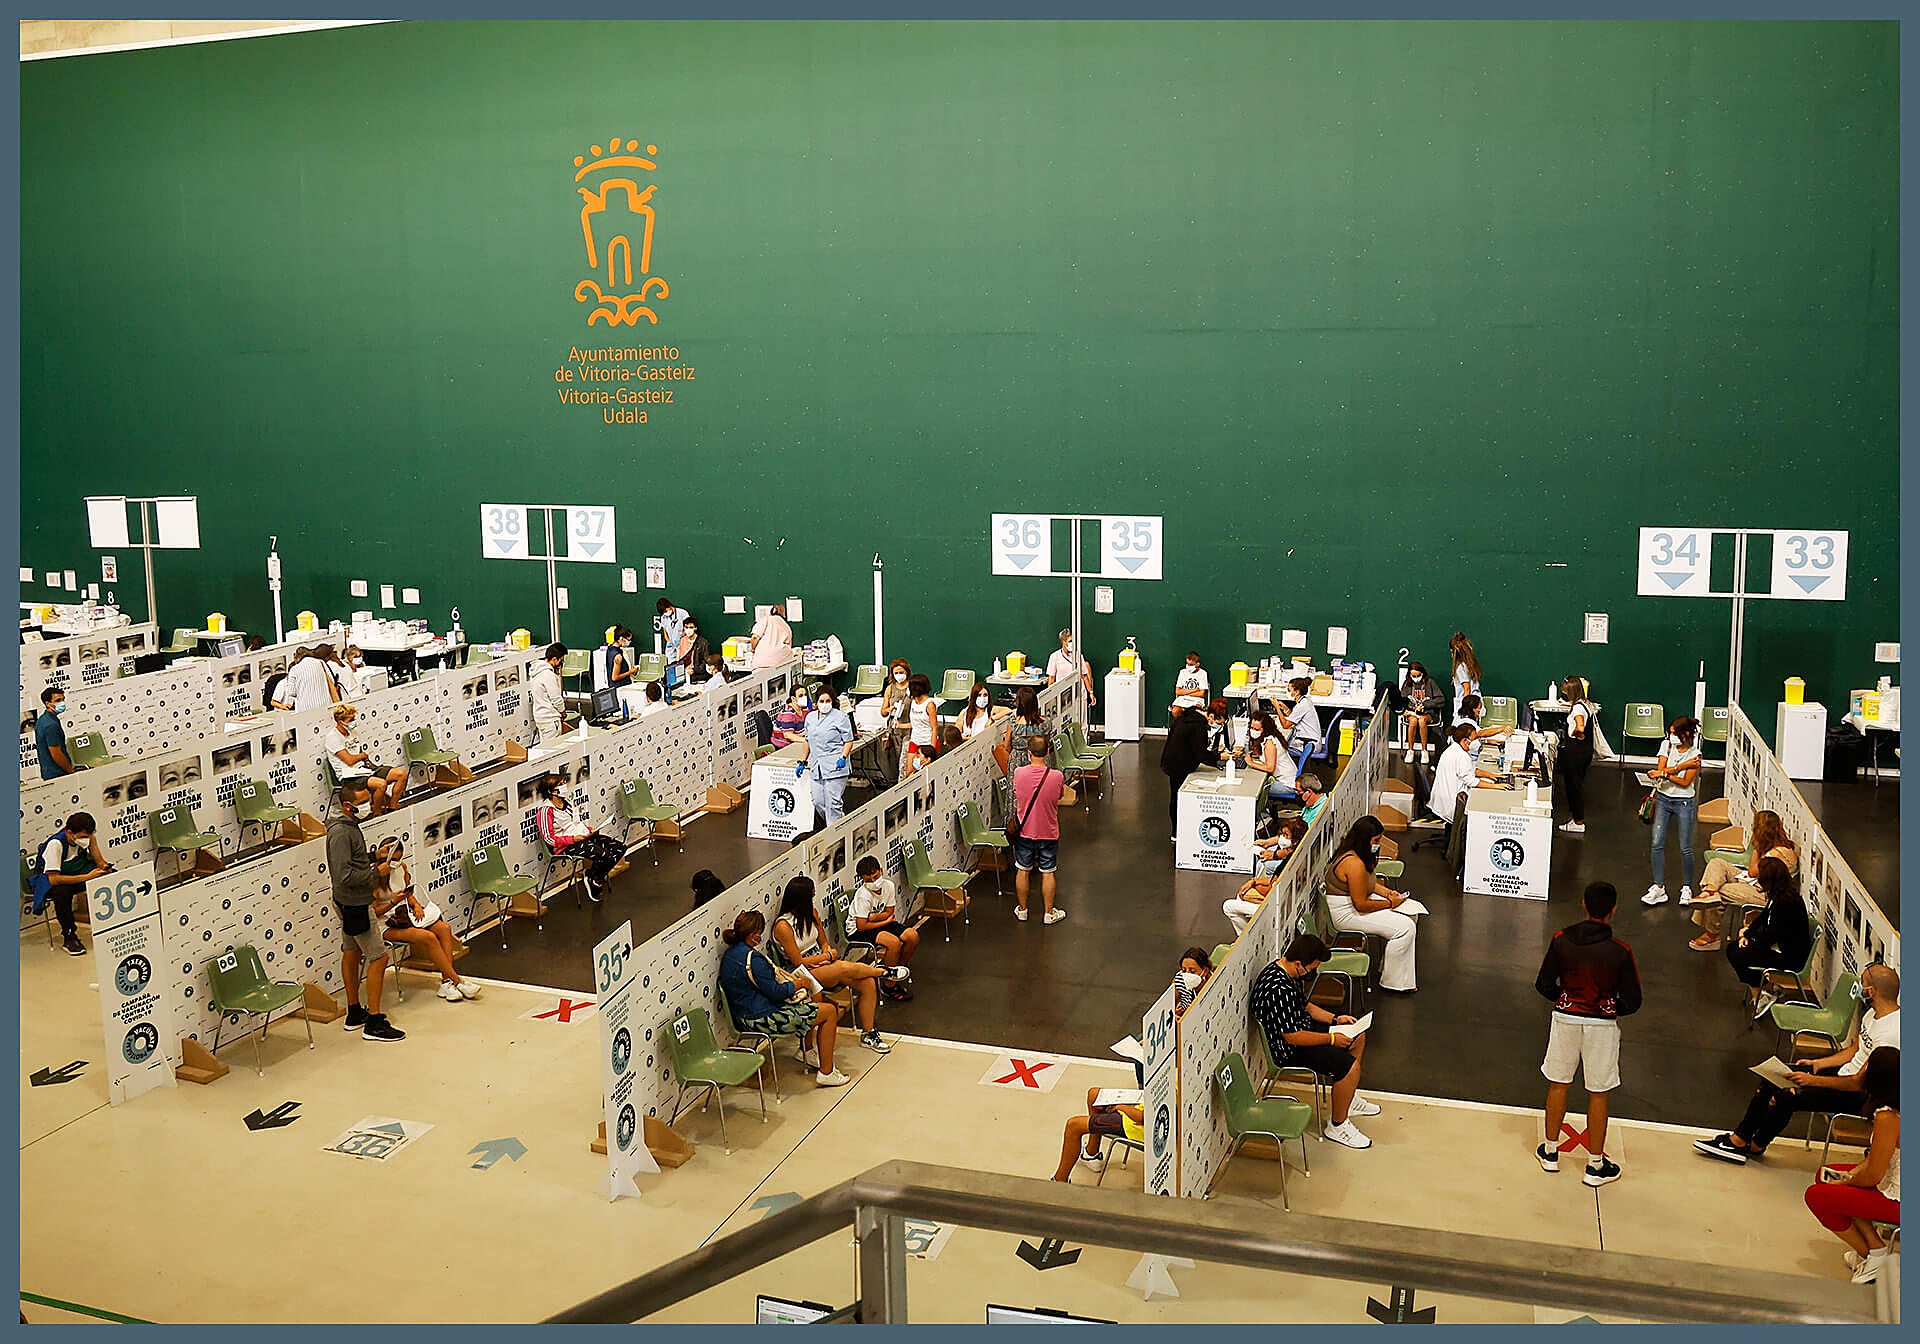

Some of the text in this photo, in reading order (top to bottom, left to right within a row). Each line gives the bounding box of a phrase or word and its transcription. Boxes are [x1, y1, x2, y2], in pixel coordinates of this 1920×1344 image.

[568, 344, 680, 365] Ayuntamiento
[555, 364, 695, 382] de Vitoria-Gasteiz
[558, 387, 674, 405] Vitoria-Gasteiz
[603, 407, 648, 424] Udala
[489, 508, 520, 535] 38
[575, 510, 606, 537] 37
[1001, 519, 1041, 549] 36
[1111, 521, 1152, 551] 35
[269, 536, 278, 551] 7
[1651, 533, 1700, 566] 34
[1785, 535, 1835, 569] 33
[872, 552, 884, 568] 4
[107, 591, 115, 604] 8
[451, 606, 460, 621] 6
[653, 615, 663, 631] 5
[1126, 636, 1136, 650] 3
[1398, 648, 1410, 665] 2
[281, 758, 290, 767] TU
[221, 774, 238, 785] NIRE
[275, 774, 286, 784] ME
[168, 789, 187, 801] ZURE
[573, 795, 589, 807] CUNA
[575, 788, 583, 797] TU
[127, 804, 137, 814] MI
[111, 812, 147, 829] VACUNA
[121, 825, 132, 834] TE
[479, 824, 495, 839] ZURE
[108, 829, 148, 848] PROTEGE
[443, 843, 454, 855] MI
[430, 850, 461, 871] VACUNA
[439, 866, 448, 876] TE
[428, 869, 462, 892] PROTEGE
[94, 879, 136, 921] 36
[599, 941, 622, 992] 35
[112, 994, 161, 1018] DE VACUNACIÓN
[121, 1006, 145, 1020] CONTRA
[123, 1009, 152, 1025] COVID-19
[1146, 1009, 1167, 1066] 34
[336, 1133, 397, 1157] 36
[904, 1228, 935, 1253] 5
